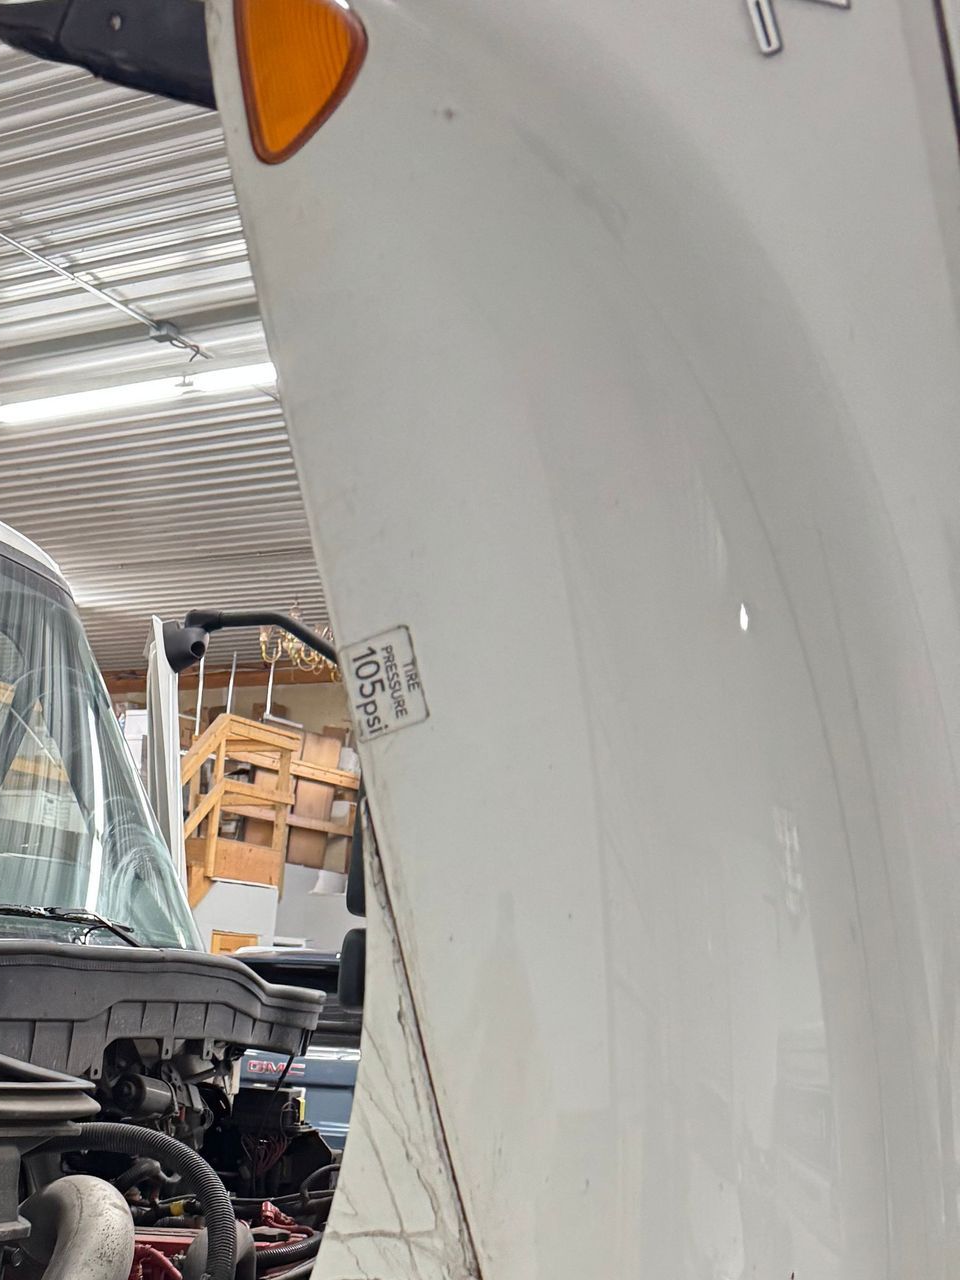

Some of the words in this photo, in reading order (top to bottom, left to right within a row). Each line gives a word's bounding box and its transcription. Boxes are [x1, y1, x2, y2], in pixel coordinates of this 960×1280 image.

[381, 645, 408, 719] PRESSURE
[403, 660, 420, 693] TIRE
[247, 1060, 306, 1076] GMC
